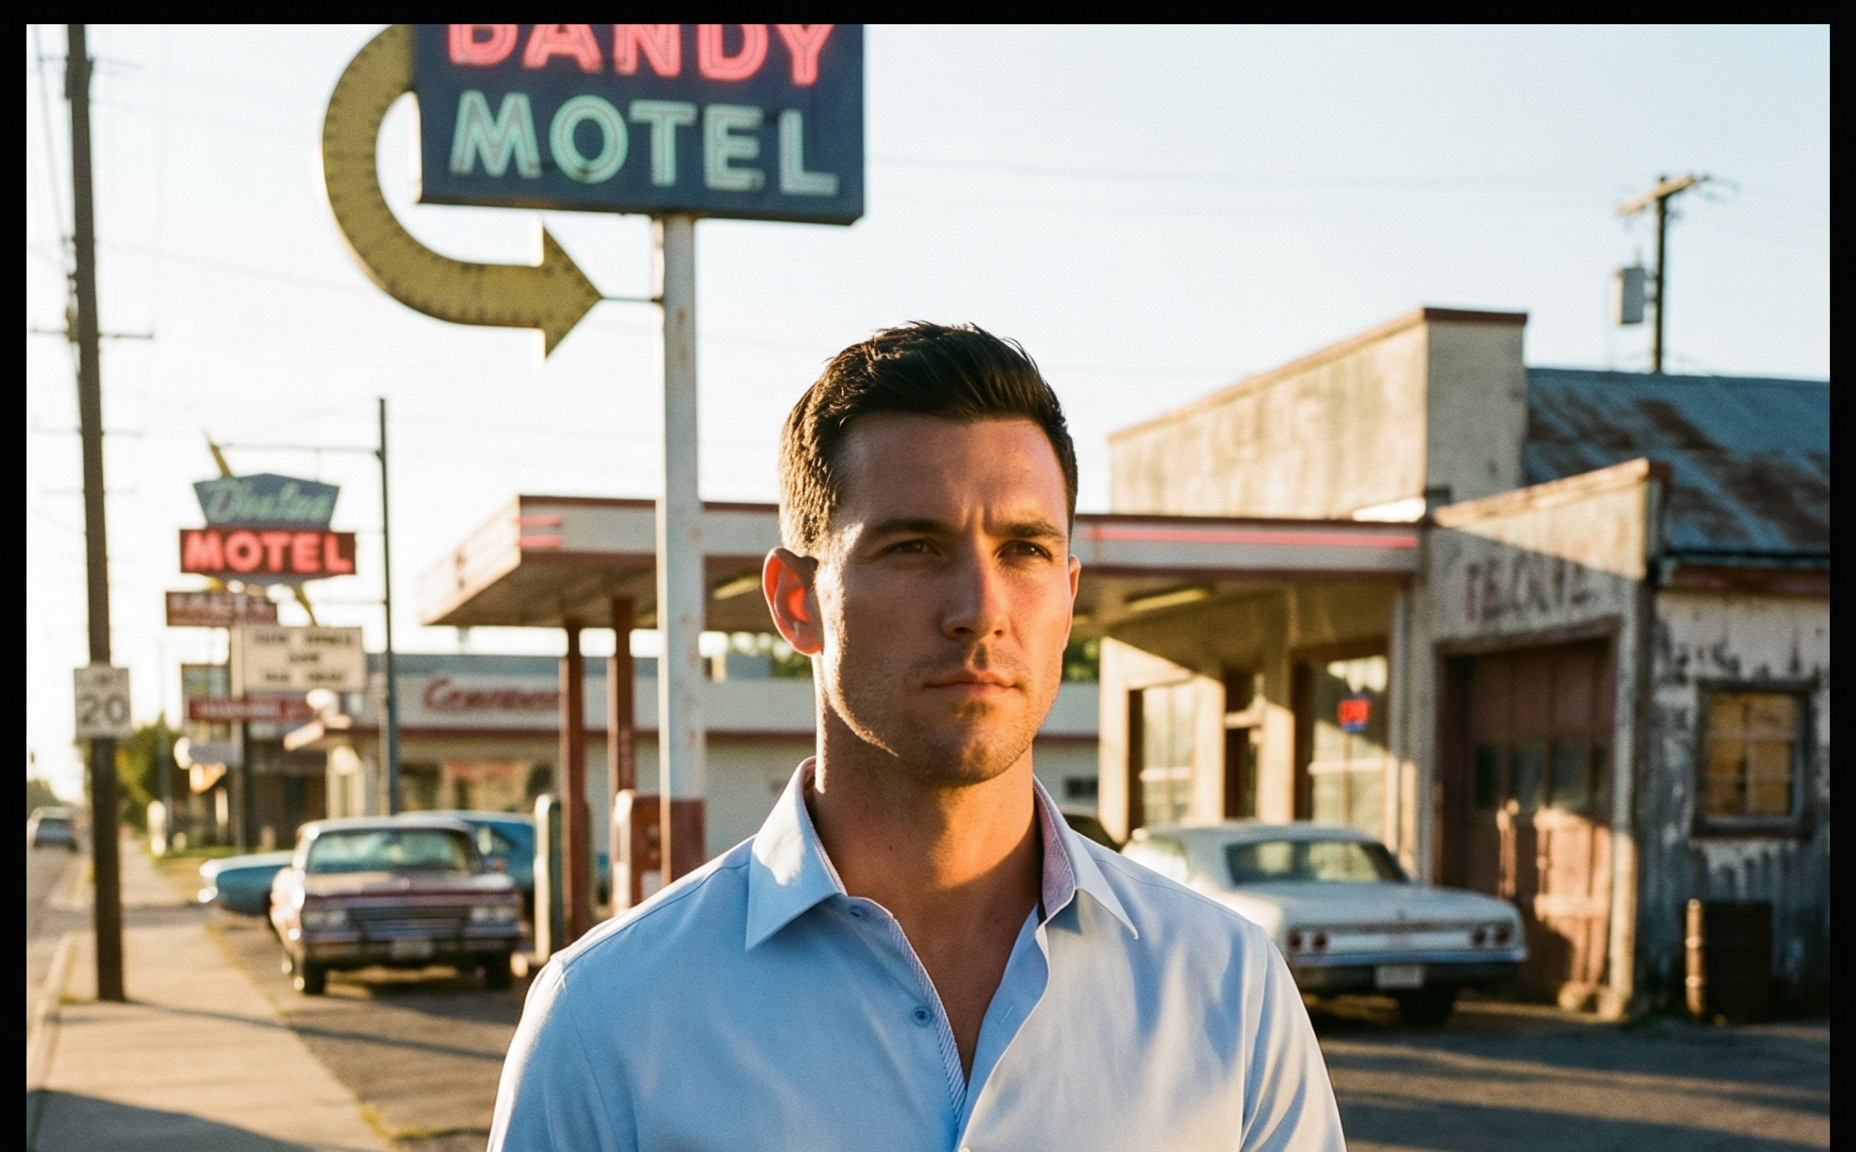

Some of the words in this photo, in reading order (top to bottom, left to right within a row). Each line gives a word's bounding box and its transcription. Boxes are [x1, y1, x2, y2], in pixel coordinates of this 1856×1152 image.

[448, 89, 839, 197] MOTEL
[182, 530, 354, 573] MOTEL
[80, 693, 128, 727] 20
